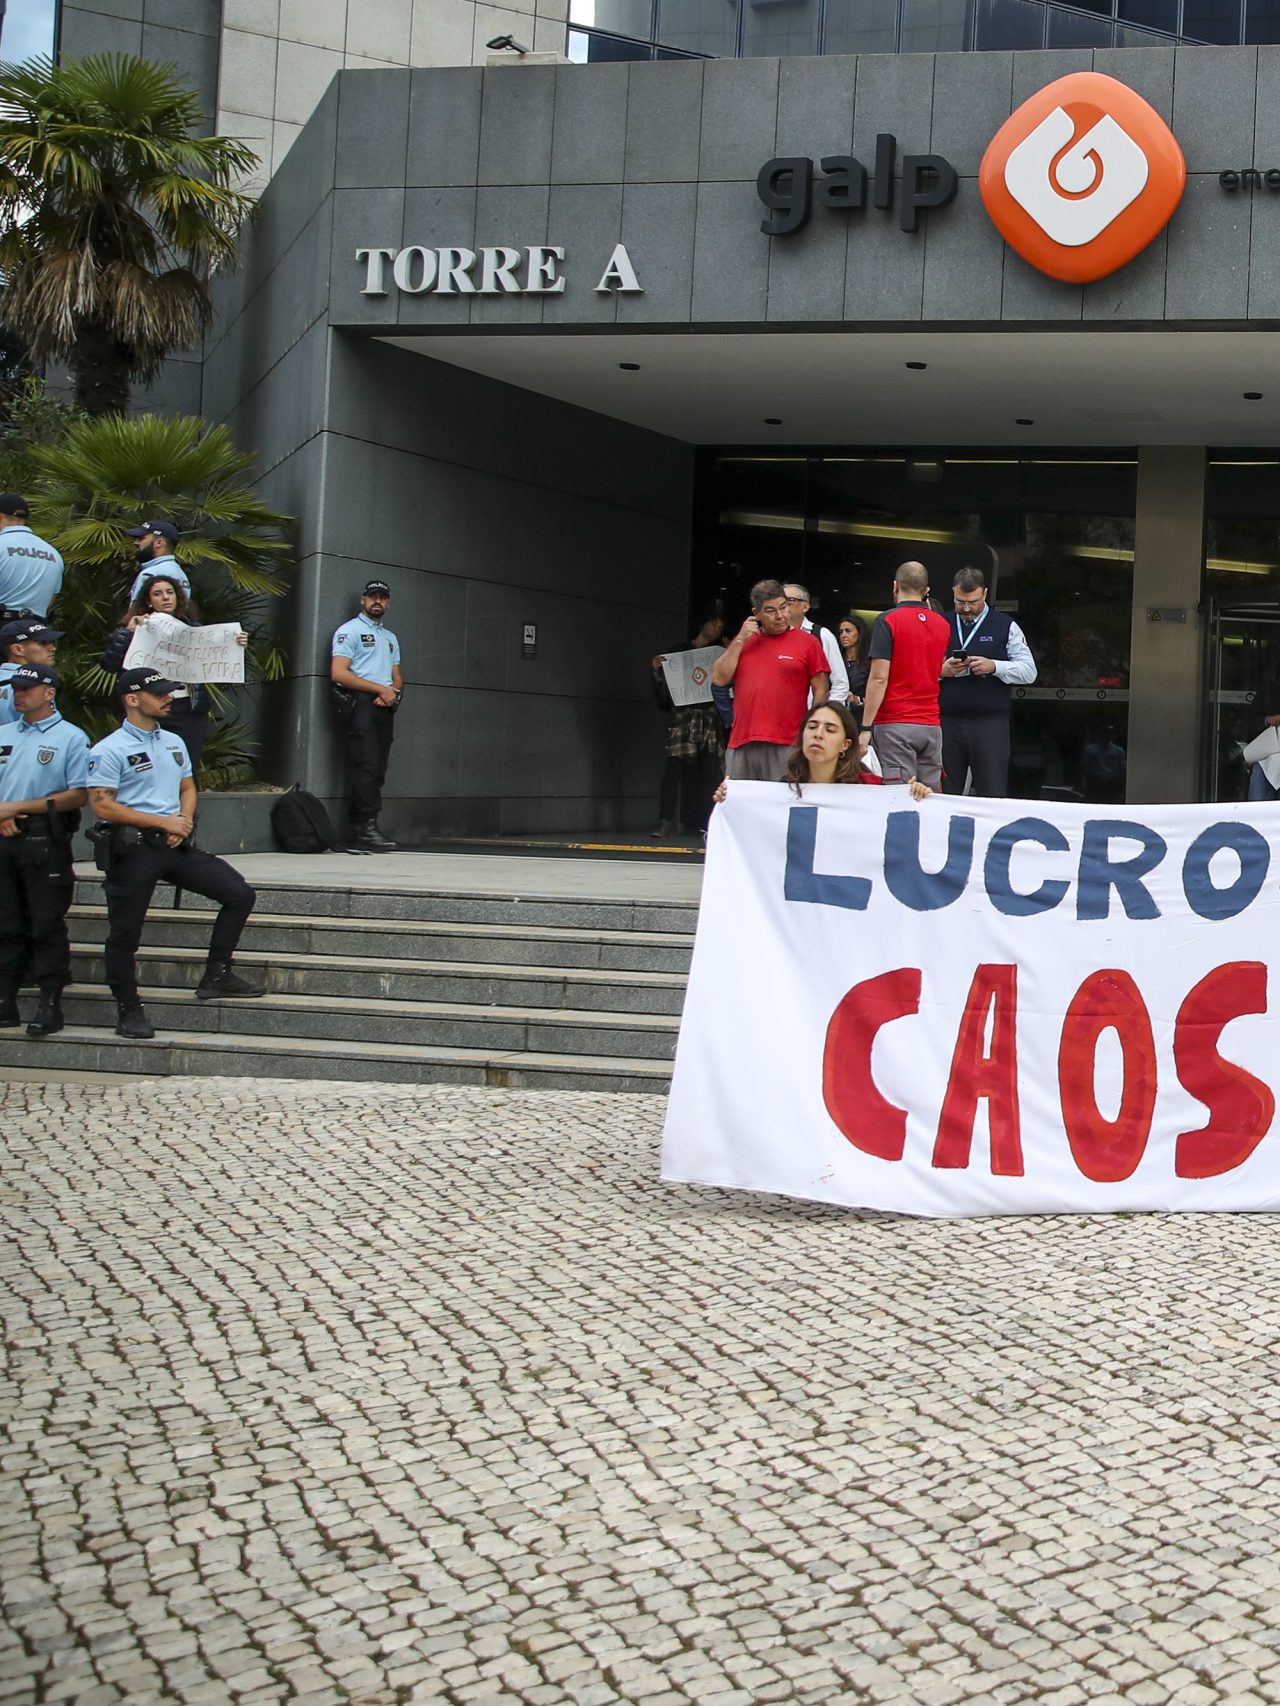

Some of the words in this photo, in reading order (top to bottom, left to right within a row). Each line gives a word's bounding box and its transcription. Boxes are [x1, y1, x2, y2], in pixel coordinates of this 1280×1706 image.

[757, 134, 958, 236] galp
[355, 245, 566, 296] TORRE
[593, 242, 645, 294] A
[822, 960, 1276, 1183] CAOS
